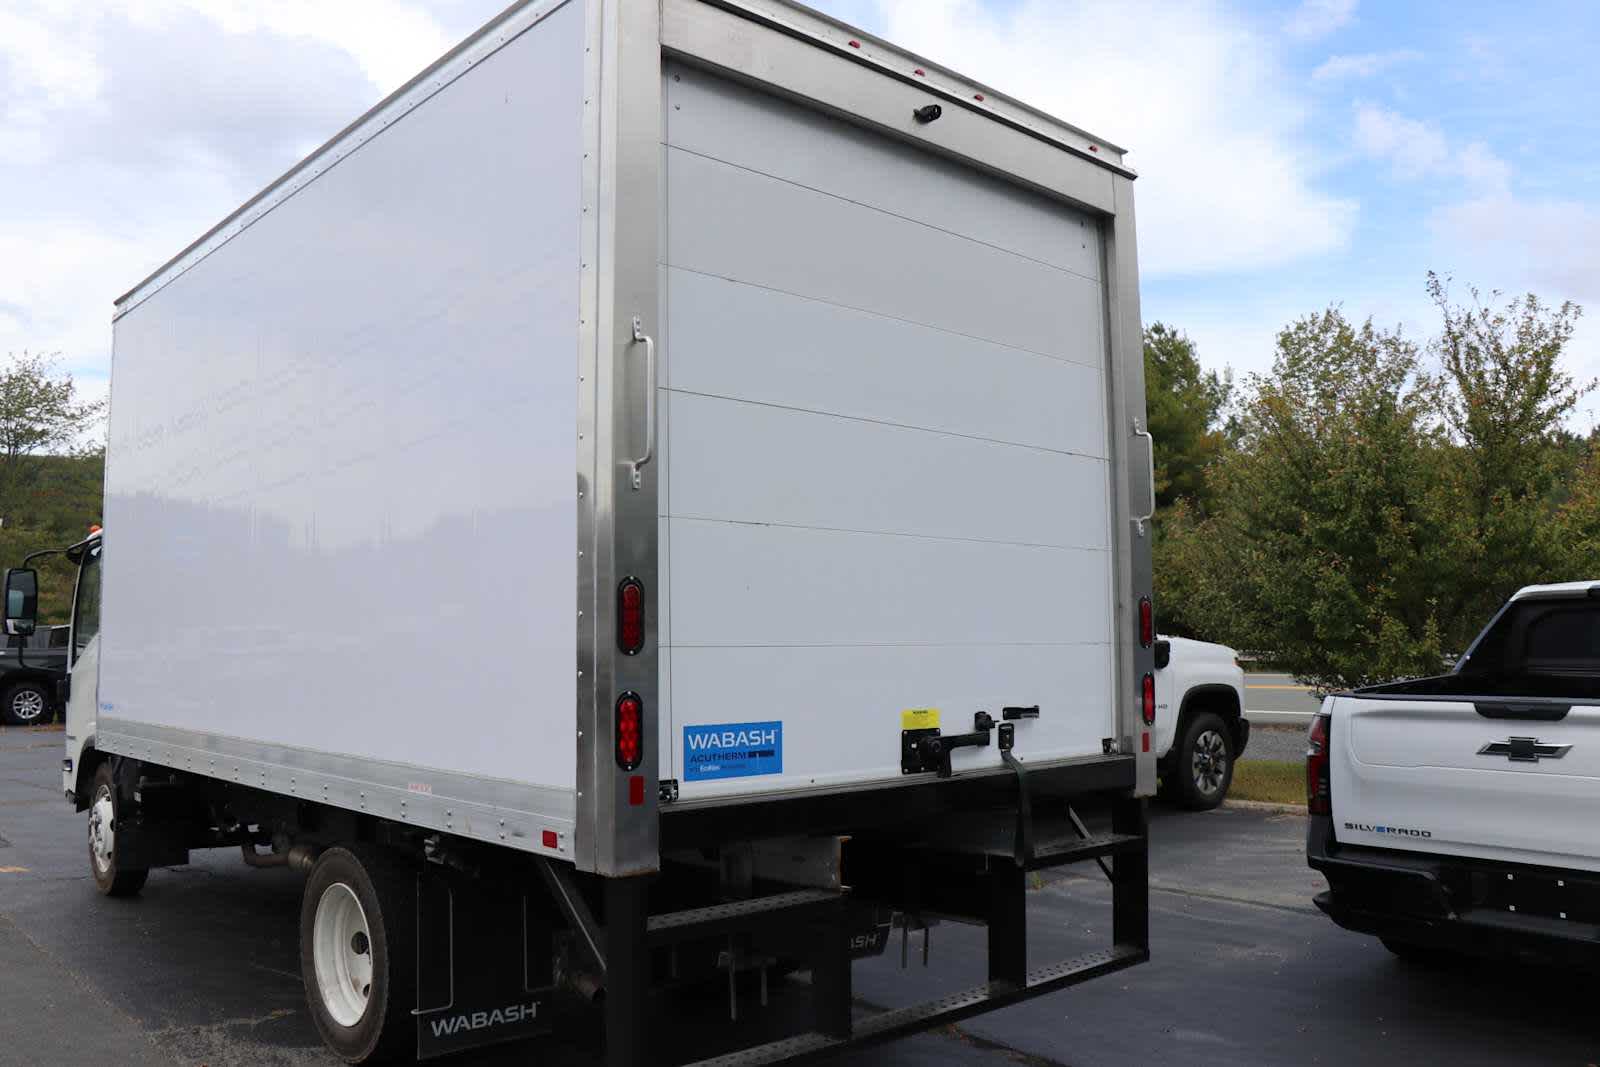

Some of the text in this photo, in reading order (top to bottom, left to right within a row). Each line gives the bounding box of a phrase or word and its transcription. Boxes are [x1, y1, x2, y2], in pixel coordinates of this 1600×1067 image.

[688, 729, 775, 750] WABASH
[690, 752, 745, 764] ACUTHERM
[1344, 822, 1431, 837] SILVERADO
[430, 1002, 537, 1037] WABASH
